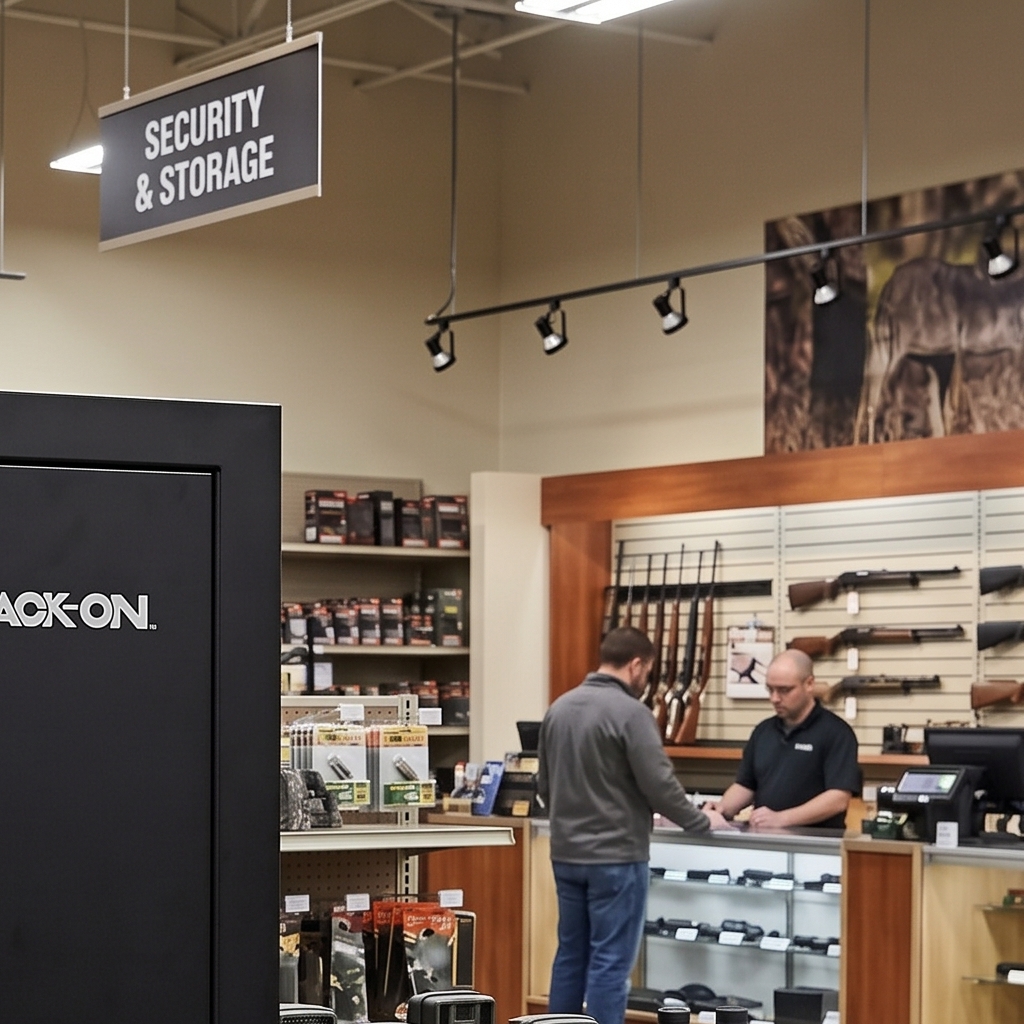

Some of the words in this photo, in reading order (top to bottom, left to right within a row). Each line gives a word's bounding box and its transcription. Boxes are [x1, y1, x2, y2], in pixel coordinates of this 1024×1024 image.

[144, 85, 265, 160] SECURITY
[134, 173, 153, 213] &
[159, 135, 274, 206] STORAGE
